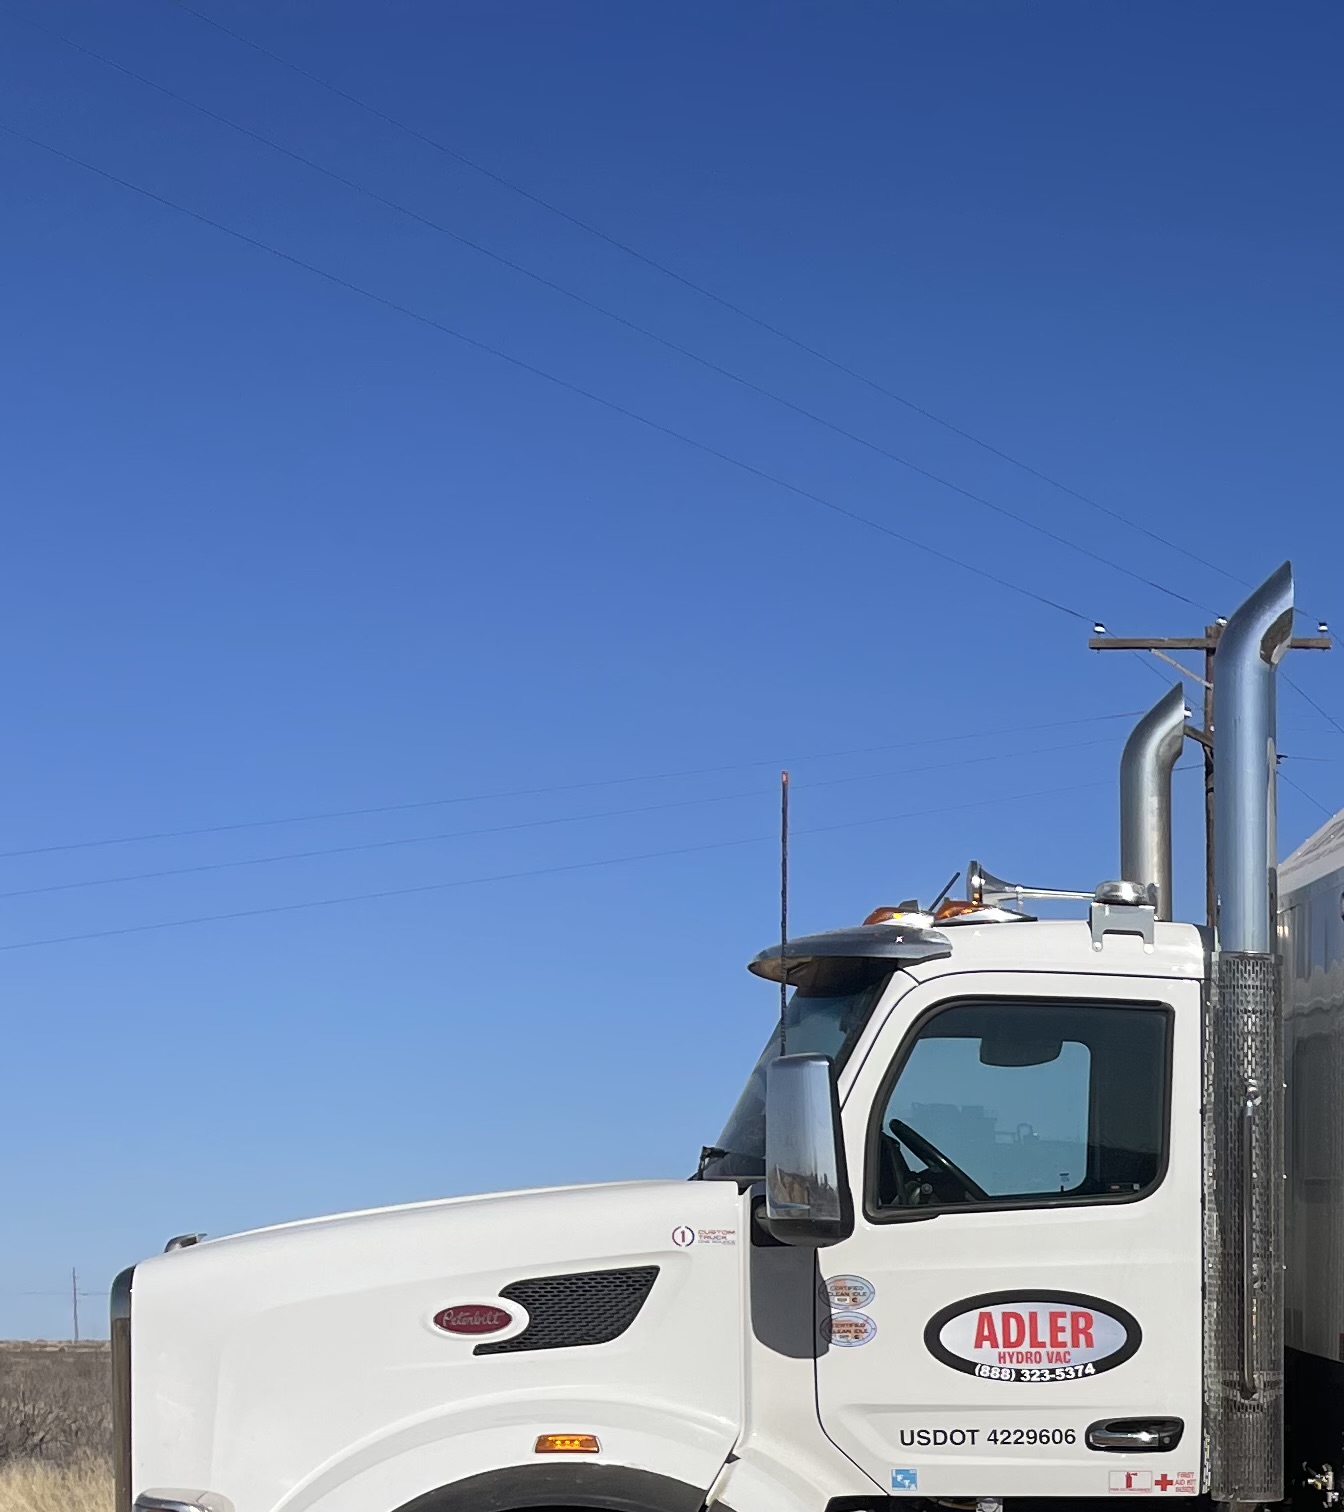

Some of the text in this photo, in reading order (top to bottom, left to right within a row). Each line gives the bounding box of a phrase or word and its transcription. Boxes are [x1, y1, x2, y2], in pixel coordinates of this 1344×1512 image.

[442, 1309, 506, 1327] Peterbilt
[973, 1311, 1095, 1349] ADLER
[997, 1350, 1072, 1365] HYDRO VAC
[974, 1362, 1096, 1382] (888) 323-5374
[899, 1428, 1077, 1446] USDOT 4229606
